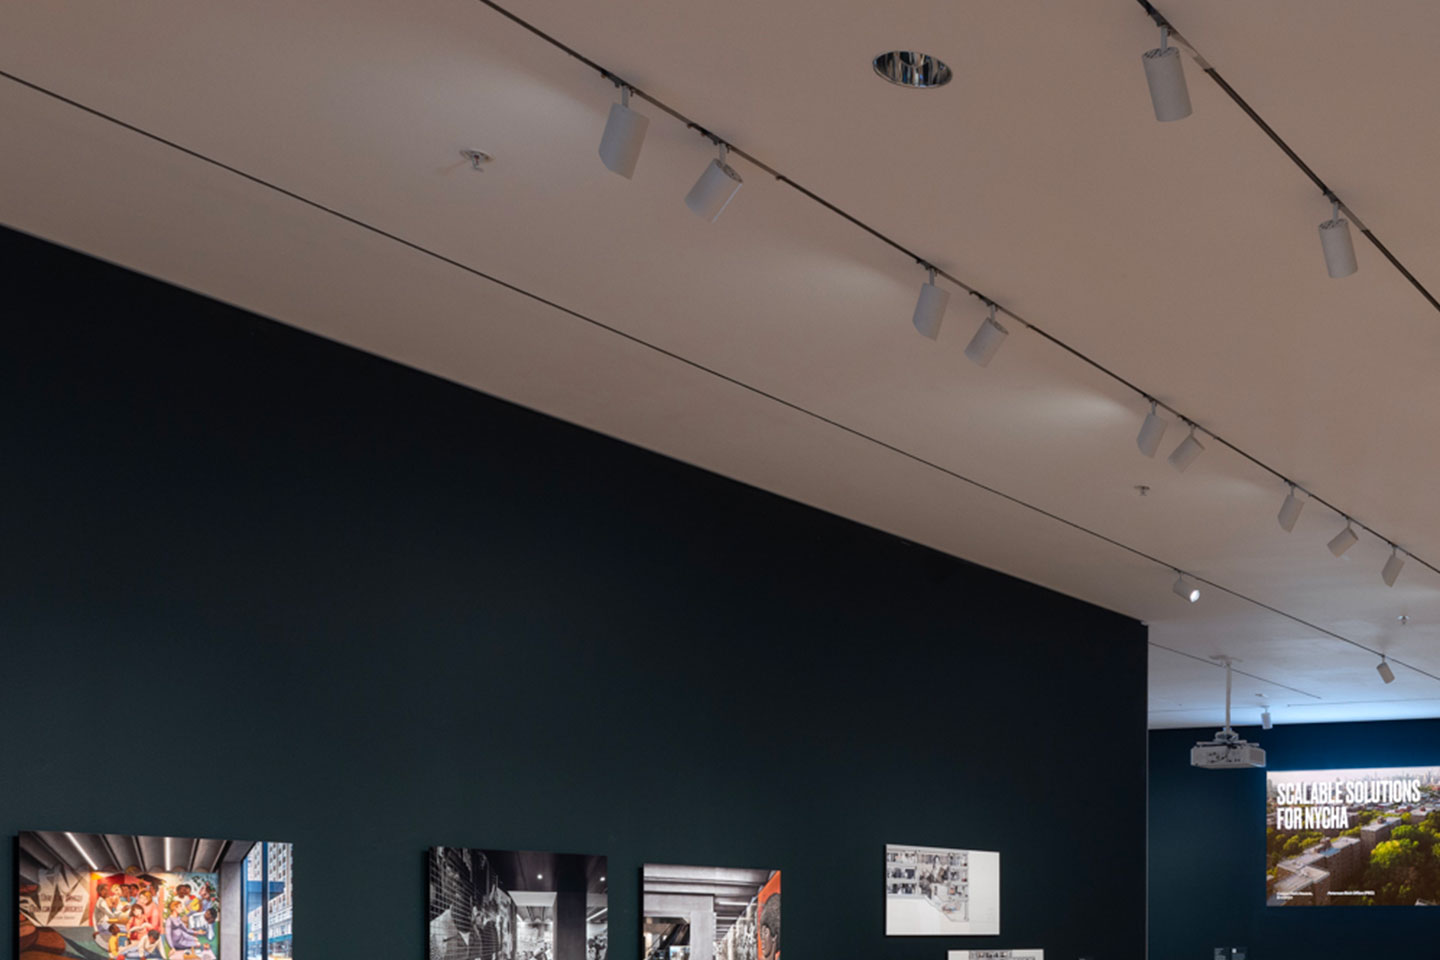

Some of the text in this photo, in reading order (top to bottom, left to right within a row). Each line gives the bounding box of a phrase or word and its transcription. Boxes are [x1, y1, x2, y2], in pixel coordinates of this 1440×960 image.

[1277, 779, 1421, 805] SCALABLE SOLUTIONS
[1277, 806, 1349, 830] FOR NYCHA
